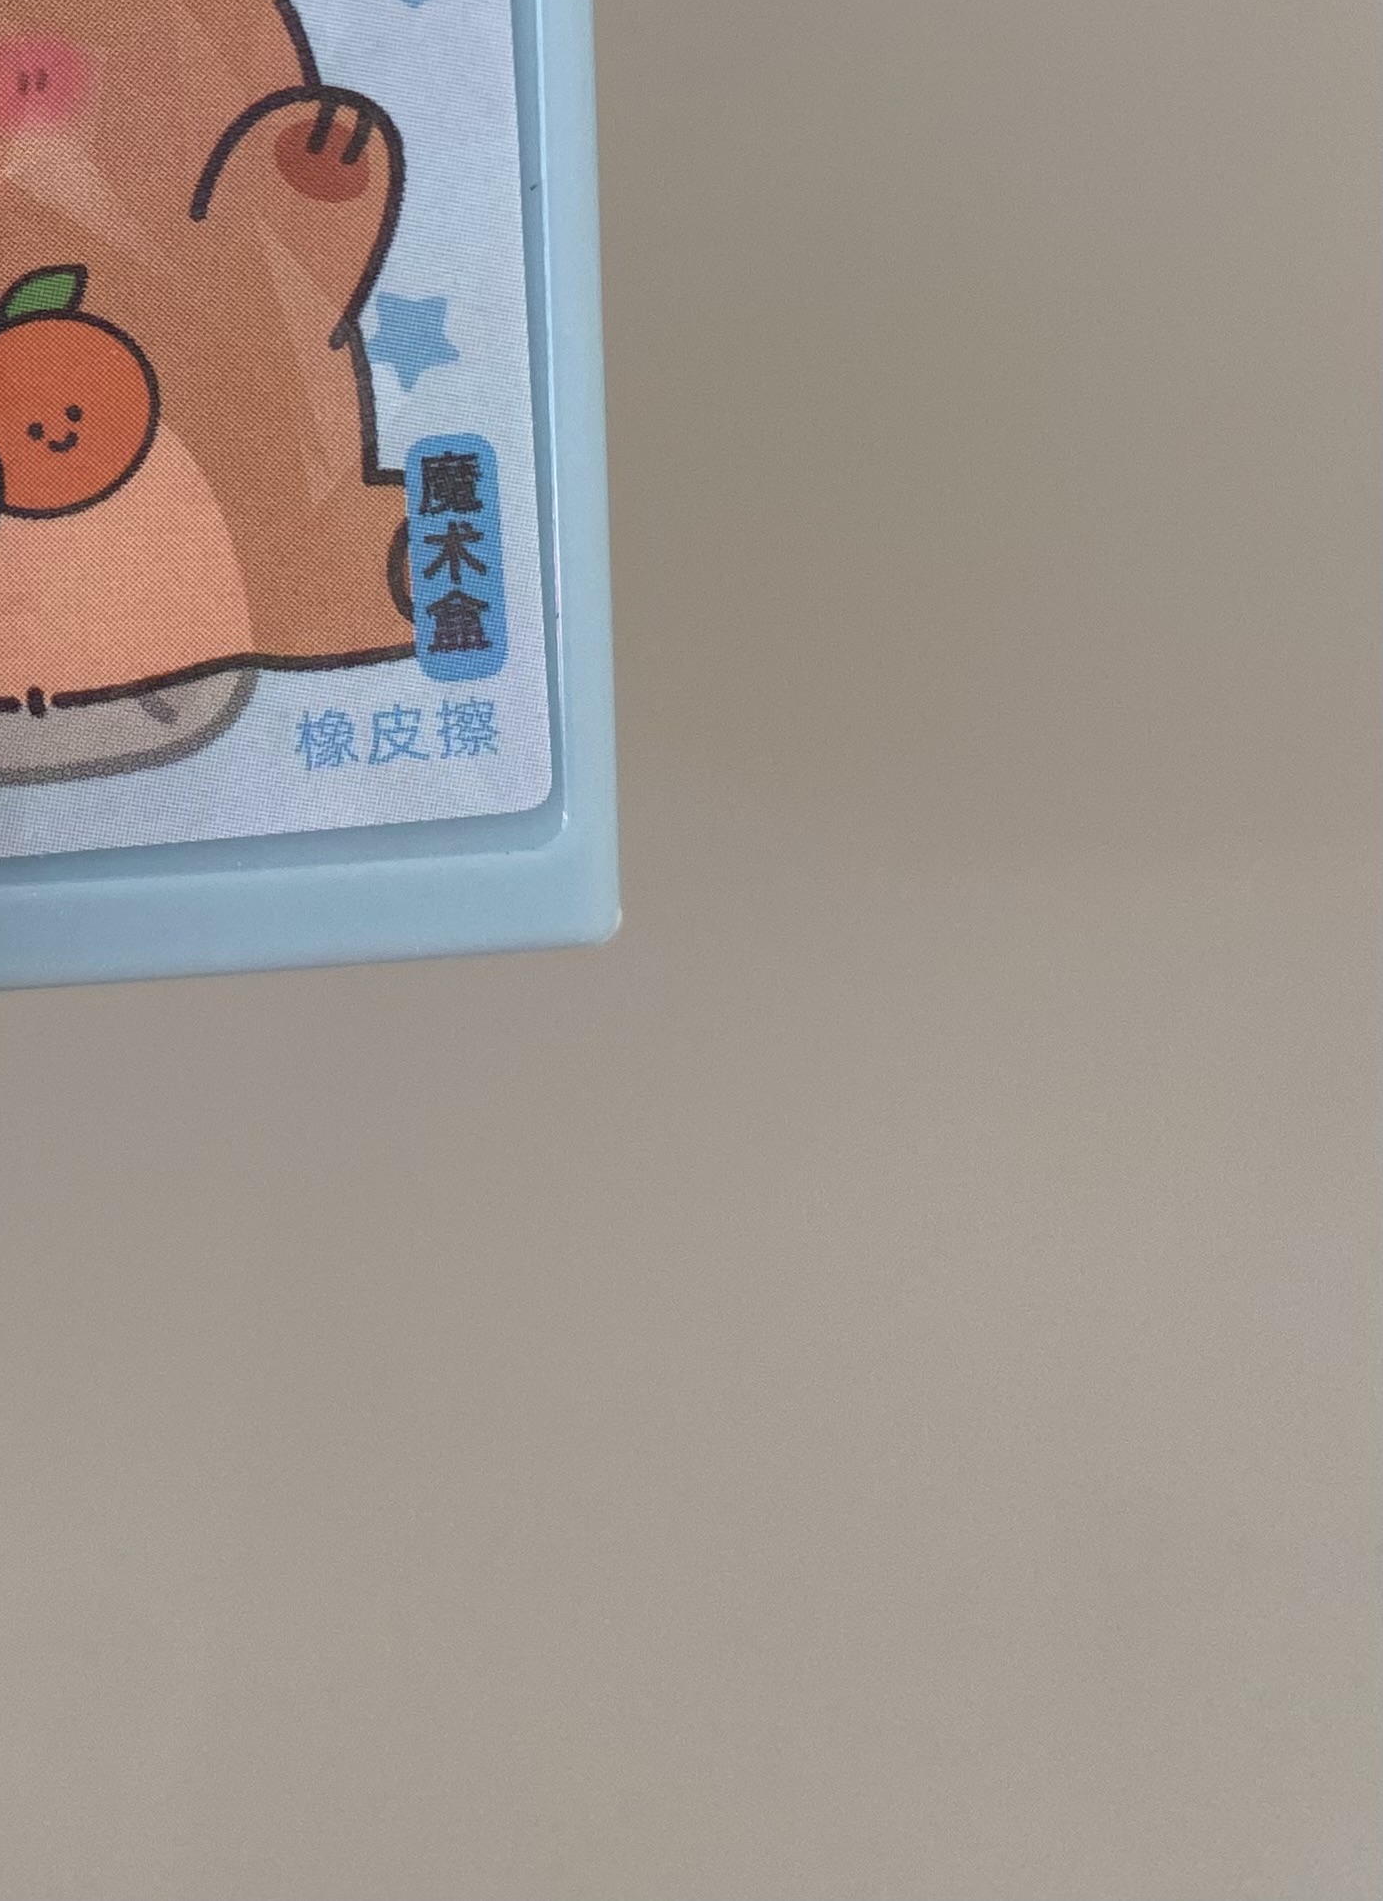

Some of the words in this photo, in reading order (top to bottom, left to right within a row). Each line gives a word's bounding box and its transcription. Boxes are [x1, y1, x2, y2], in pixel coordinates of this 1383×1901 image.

[419, 450, 493, 654] 魔术盒
[295, 698, 500, 771] 橡皮擦
